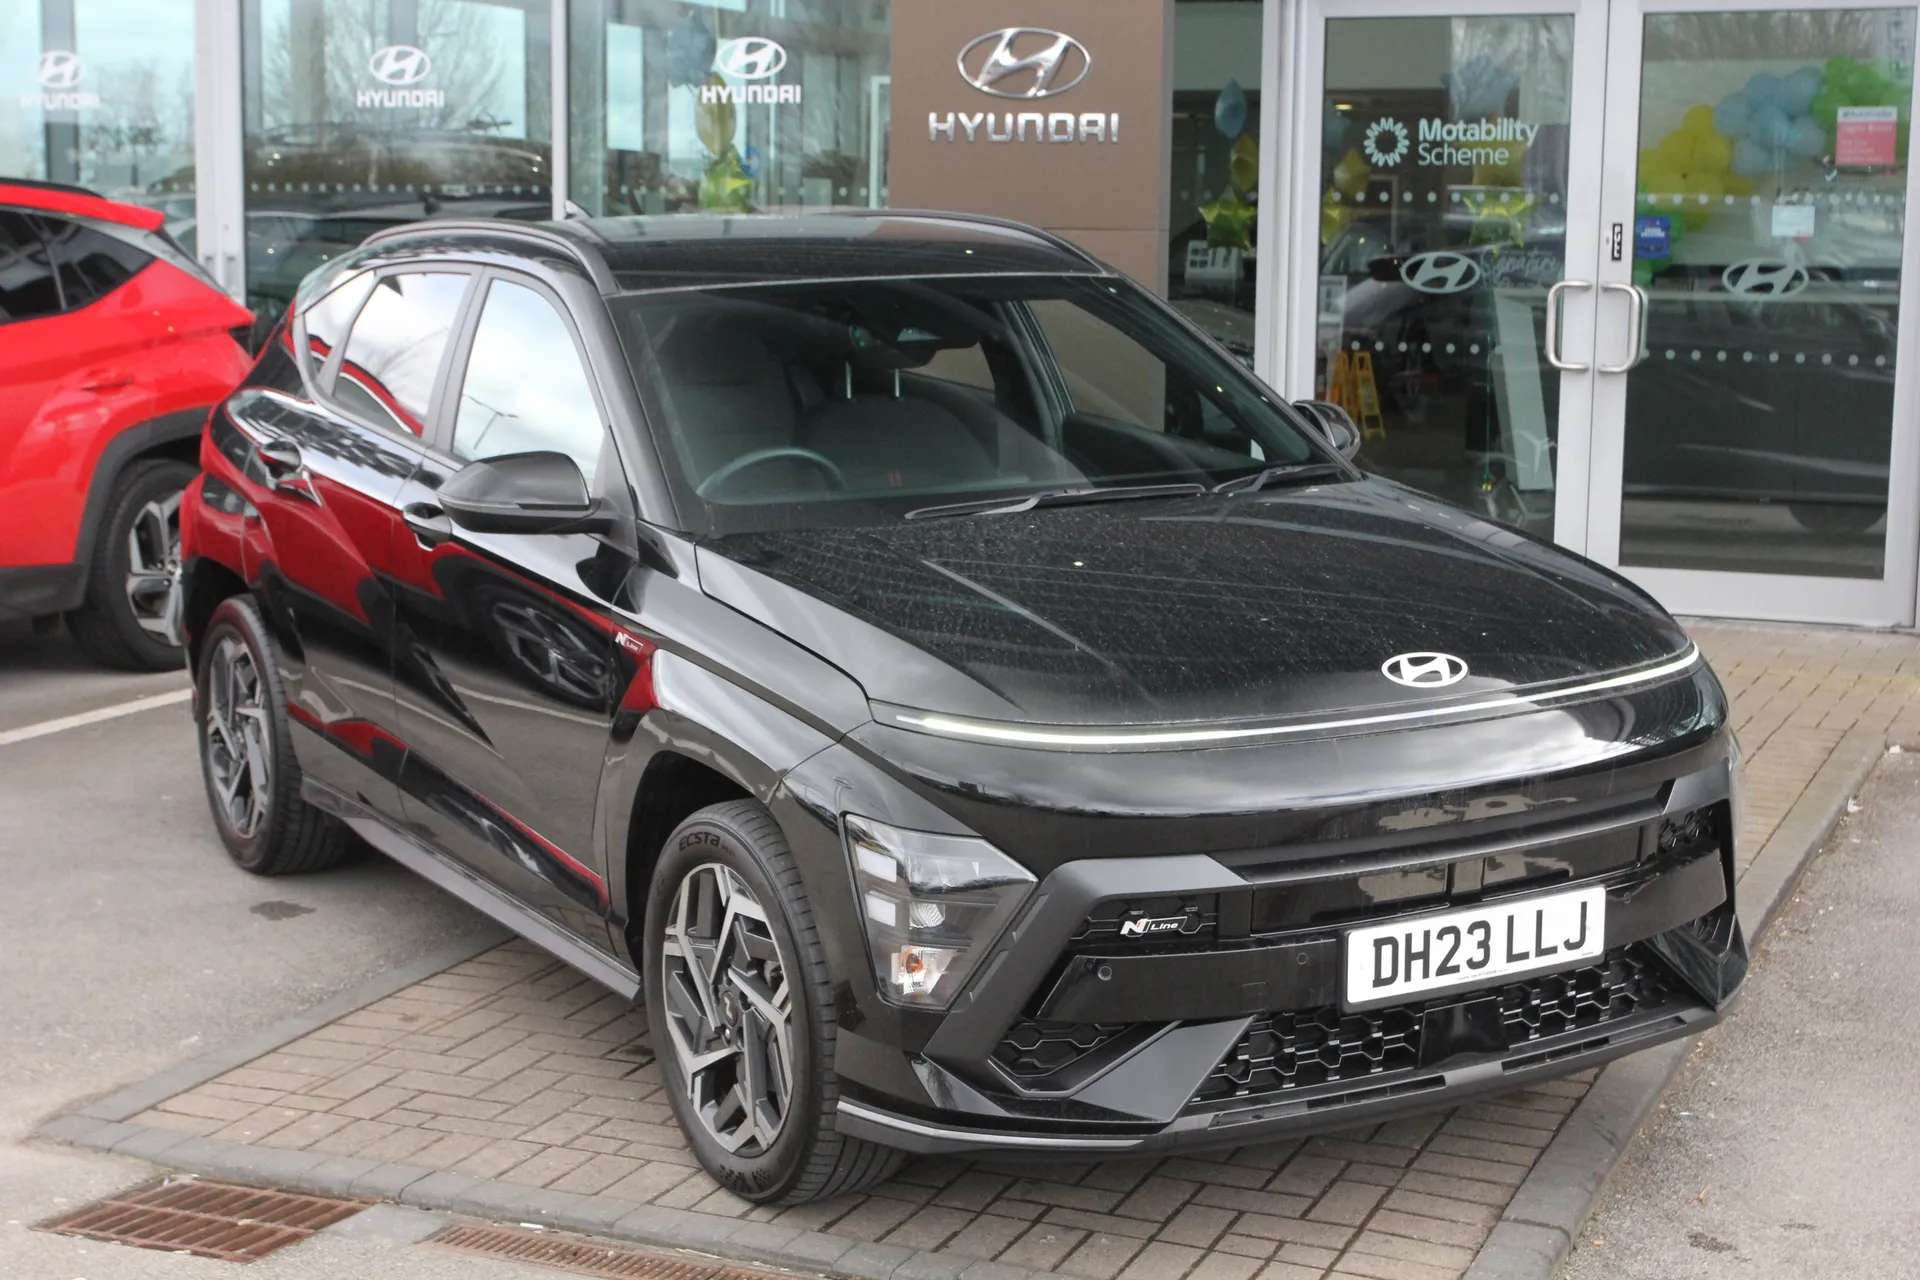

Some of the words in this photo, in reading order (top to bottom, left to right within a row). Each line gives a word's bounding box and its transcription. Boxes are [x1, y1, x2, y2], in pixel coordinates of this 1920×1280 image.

[356, 88, 445, 108] HYUNDAI
[701, 84, 802, 104] HYUNDAI
[928, 112, 1120, 142] HYUNDAI
[1418, 117, 1539, 148] Motability
[1418, 142, 1510, 166] Scheme
[1150, 922, 1179, 931] Line
[1372, 919, 1491, 989] DH23
[1506, 900, 1588, 964] LLJ
